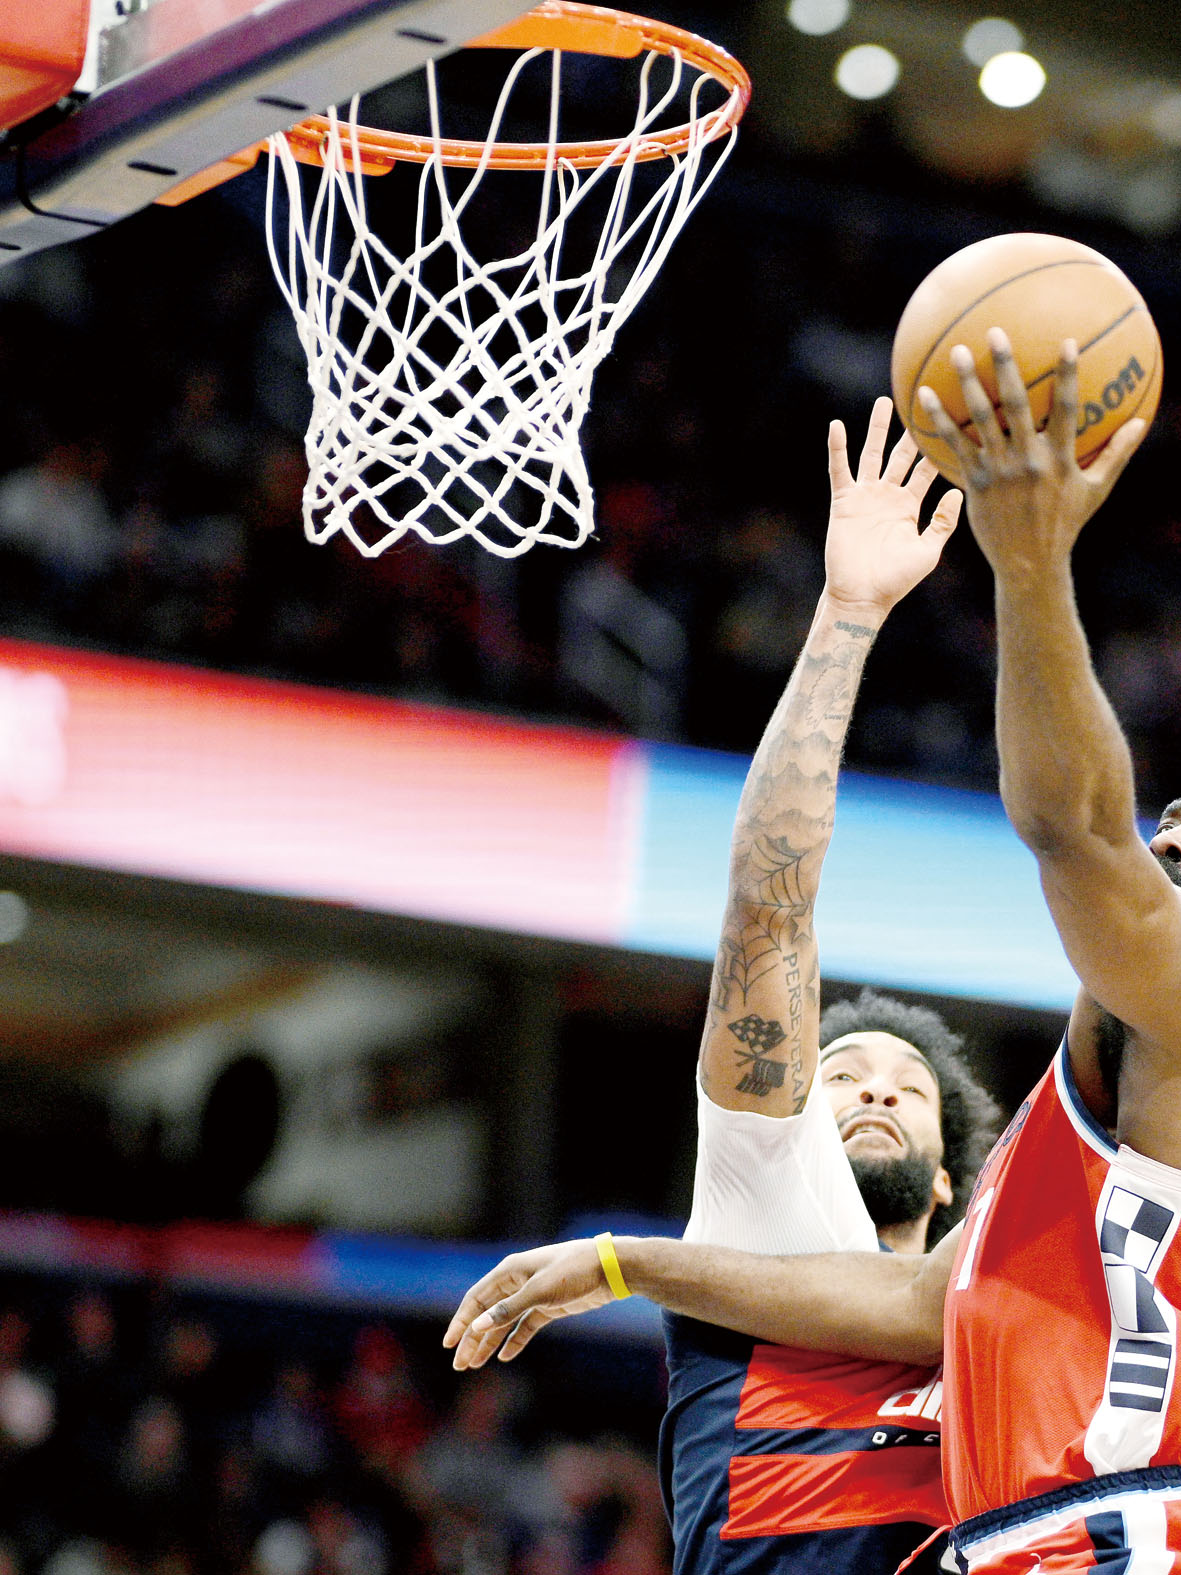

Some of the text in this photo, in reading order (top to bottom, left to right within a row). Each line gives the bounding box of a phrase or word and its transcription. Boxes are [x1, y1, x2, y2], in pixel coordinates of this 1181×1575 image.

[1076, 355, 1145, 437] son
[782, 951, 808, 1115] PERSEVERAN
[954, 1186, 995, 1291] 1
